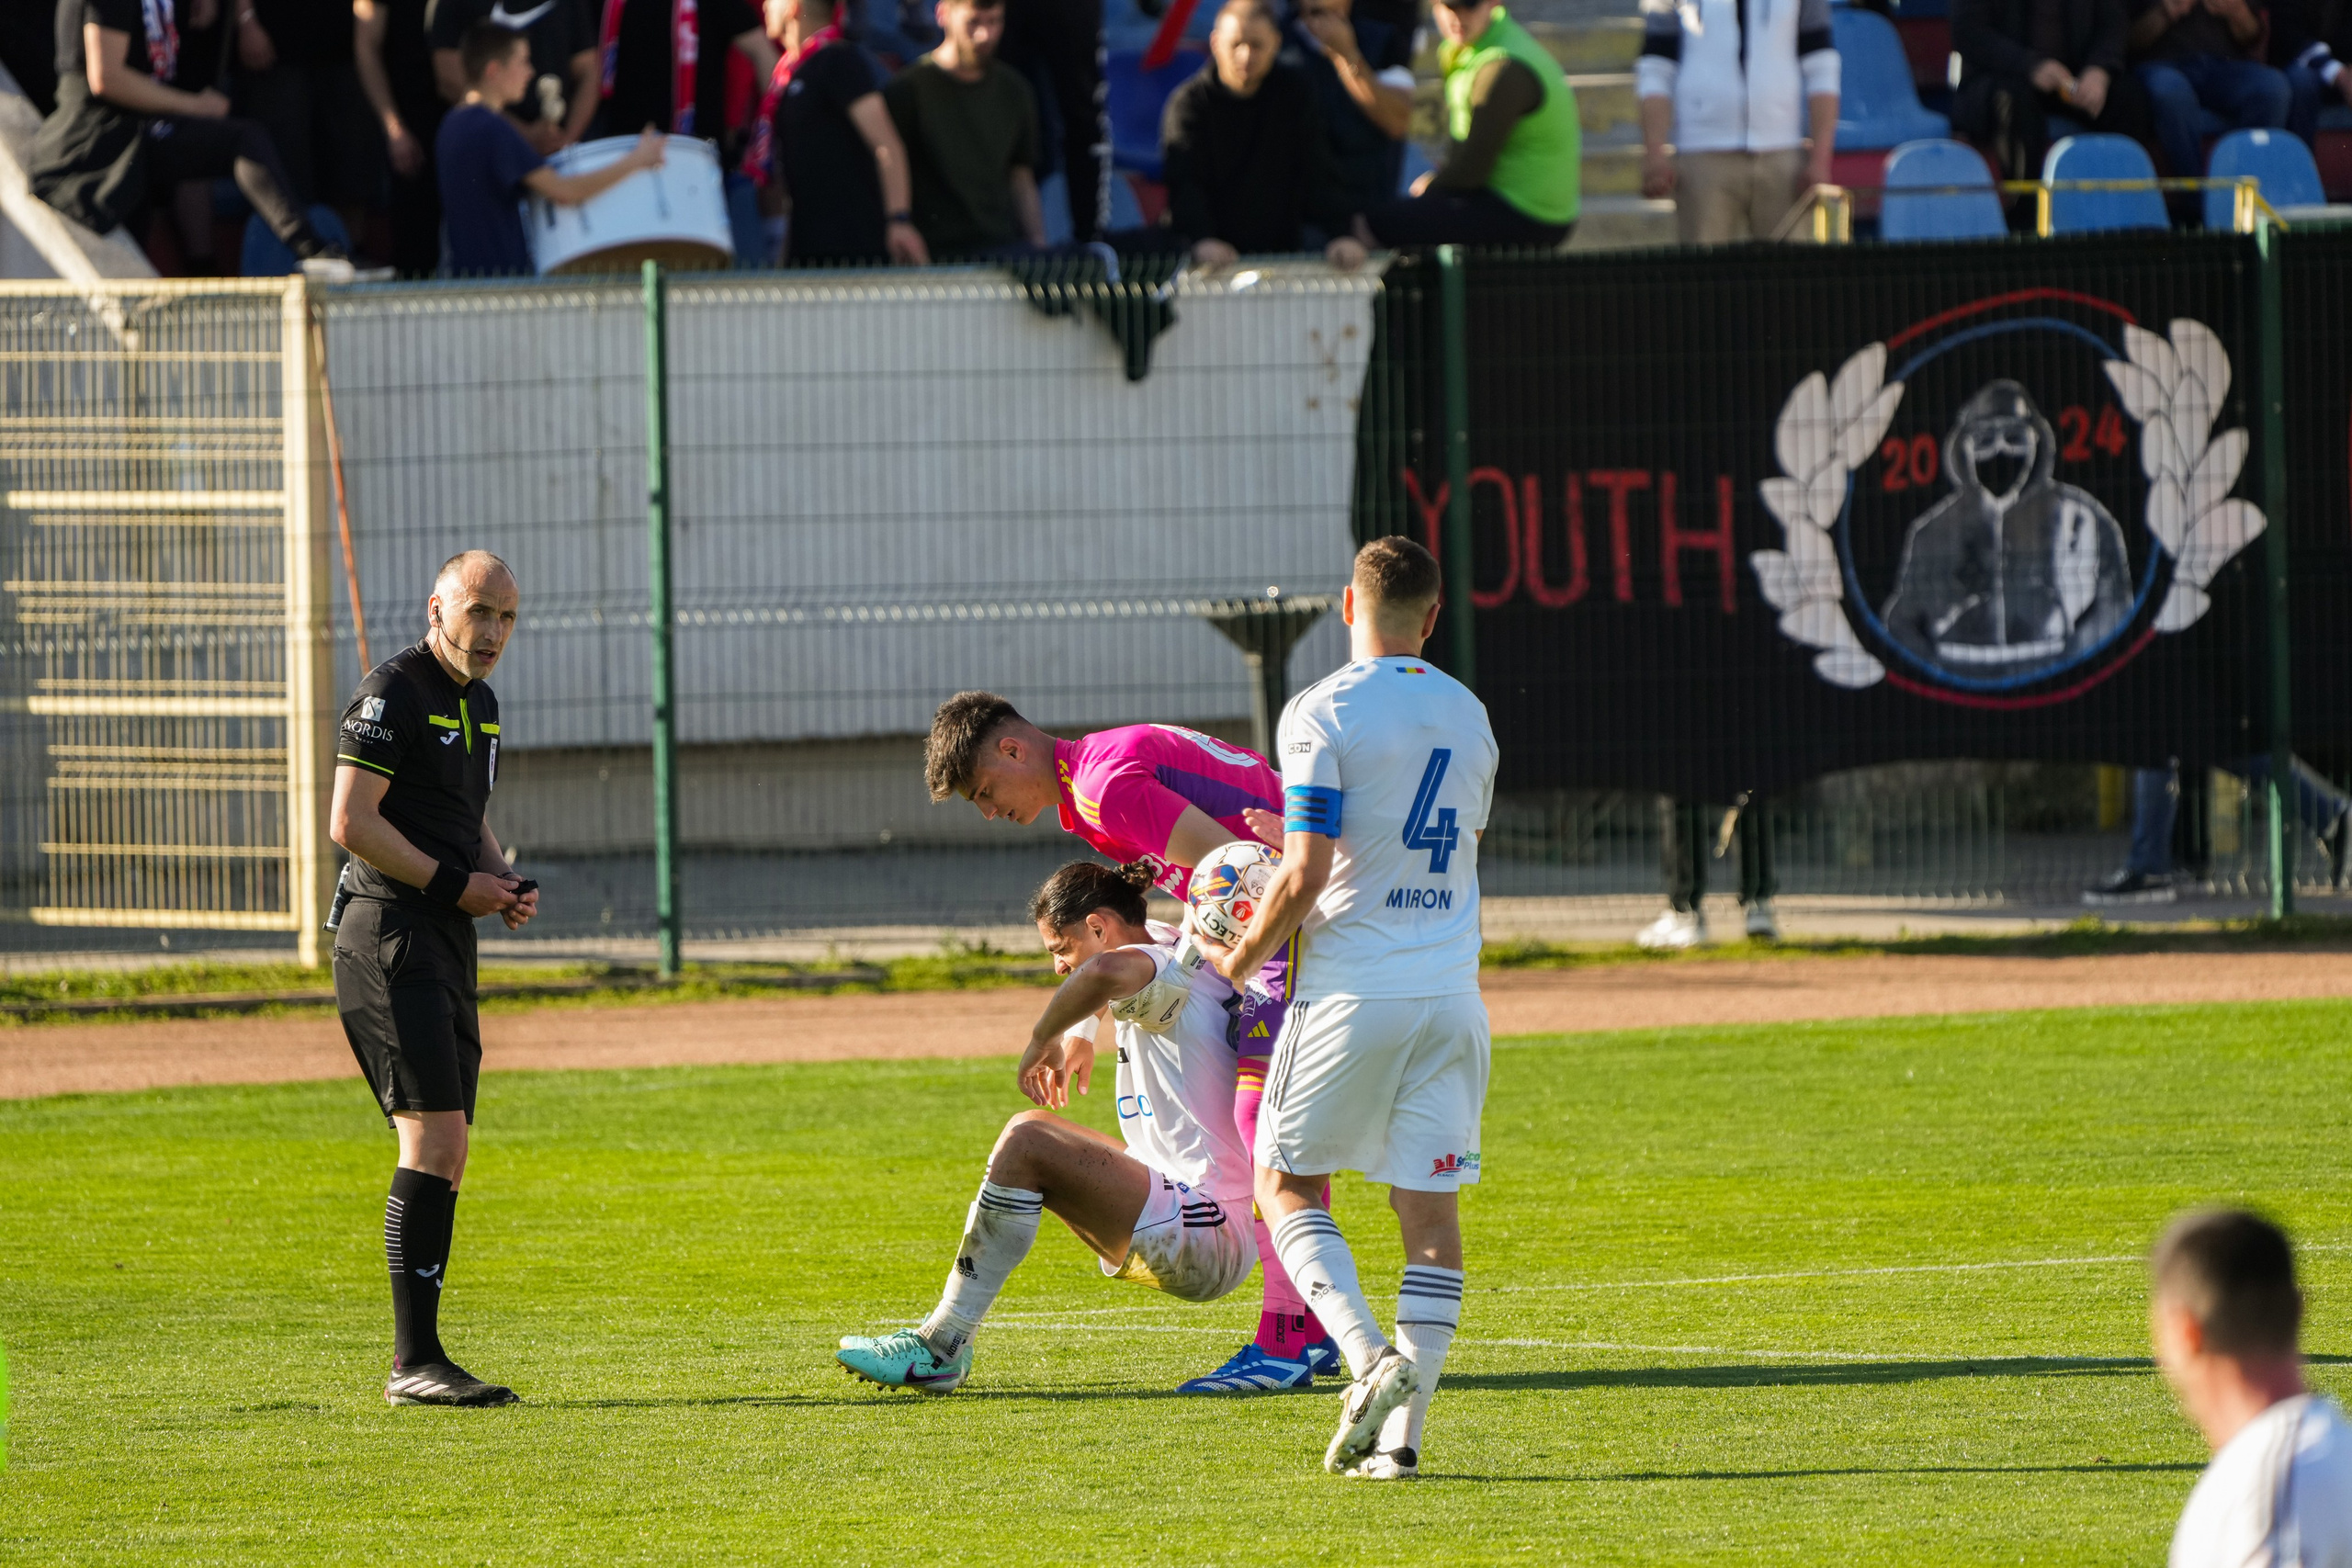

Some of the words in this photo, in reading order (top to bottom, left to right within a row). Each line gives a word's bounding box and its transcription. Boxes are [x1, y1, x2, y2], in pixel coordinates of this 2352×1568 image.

[1883, 433, 1939, 491] 20
[2059, 403, 2127, 461] 24
[1403, 467, 1736, 614] YOUTH
[344, 719, 394, 741] NORDIS
[1402, 748, 1460, 874] 4
[1202, 911, 1243, 945] ELECT
[1385, 887, 1453, 910] MIRON
